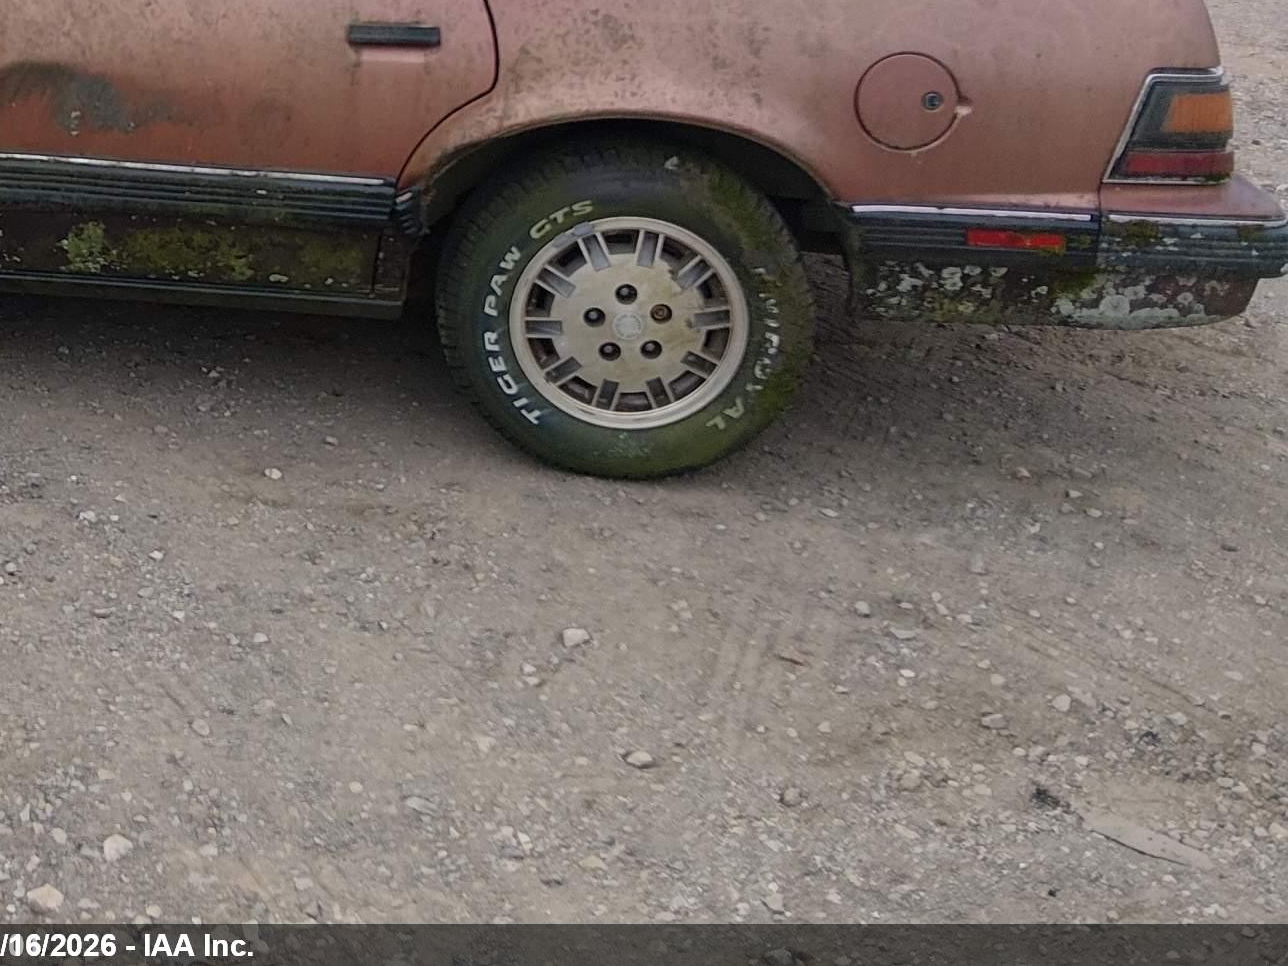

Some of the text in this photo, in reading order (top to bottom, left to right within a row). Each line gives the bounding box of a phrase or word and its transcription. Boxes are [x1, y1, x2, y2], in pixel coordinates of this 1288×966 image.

[483, 199, 595, 426] TIGER PAW GTS
